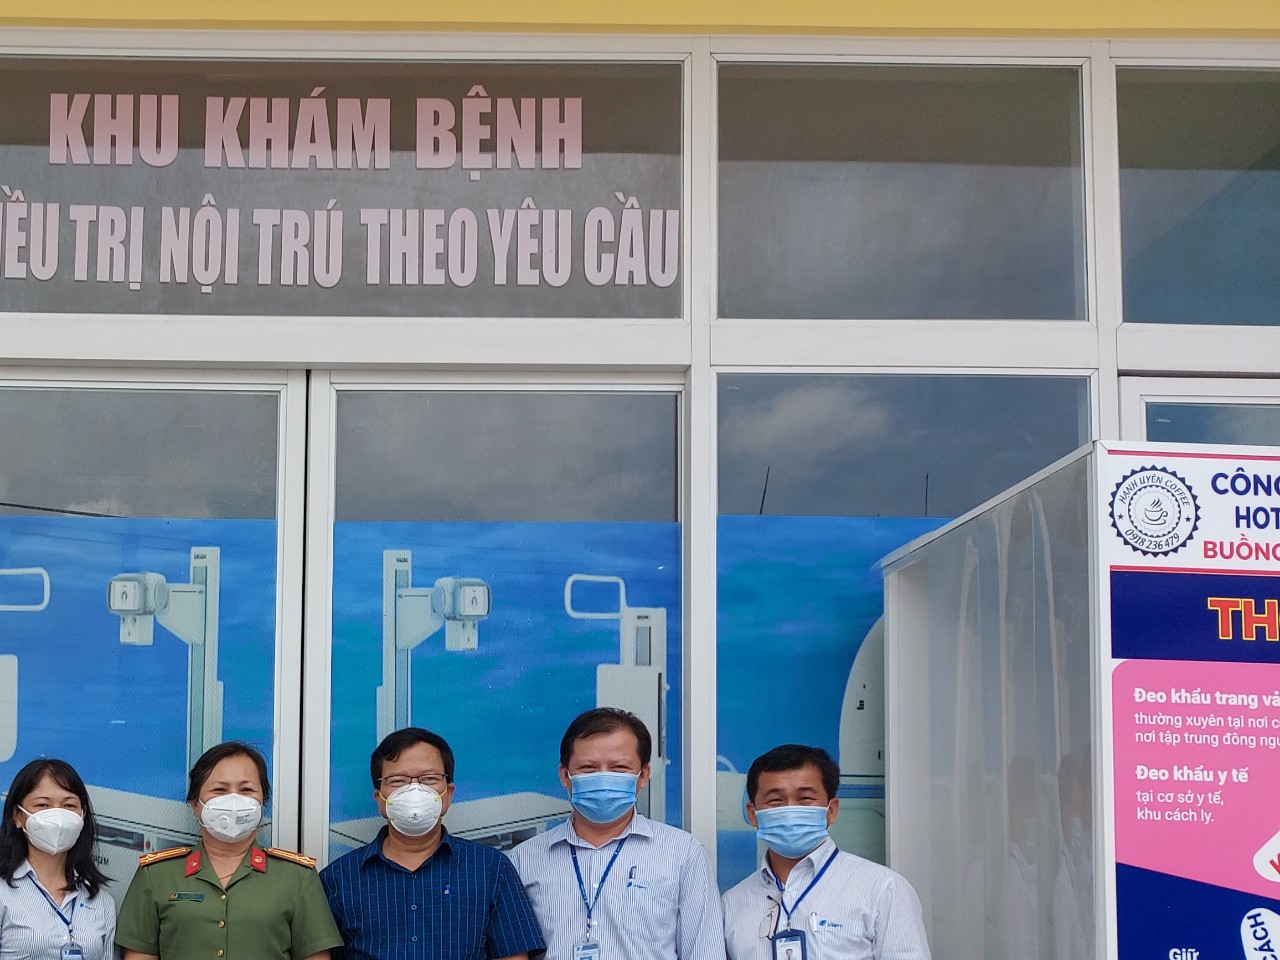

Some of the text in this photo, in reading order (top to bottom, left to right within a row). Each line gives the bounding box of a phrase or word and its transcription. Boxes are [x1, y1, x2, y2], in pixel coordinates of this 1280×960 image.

[49, 85, 582, 180] KHU KHÁM BỆNH
[69, 204, 144, 292] TRỊ
[159, 193, 239, 293] NỘI
[253, 198, 343, 287] TRÚ
[360, 207, 478, 287] THEO
[486, 196, 571, 288] YÊU
[583, 191, 680, 287] CẦU
[1139, 474, 1164, 486] UYÊN
[1164, 479, 1191, 507] COFFEE
[1124, 528, 1181, 550] 0918 236 479
[1207, 597, 1280, 642] TH
[1133, 687, 1167, 703] Đeo
[1171, 687, 1211, 705] khẩu
[1214, 690, 1259, 709] trang
[1134, 711, 1182, 729] thường
[1185, 714, 1224, 729] xuyên
[1227, 714, 1244, 729] tại
[1248, 716, 1268, 729] nơi
[1135, 731, 1156, 743] nơi
[1158, 730, 1180, 746] tập
[1184, 732, 1219, 747] trung
[1222, 731, 1256, 749] đông
[1135, 764, 1250, 786] Đeo khẩu y tế
[1136, 789, 1225, 807] tại cơ sở y tế,
[1136, 806, 1215, 825] khu cách ly.
